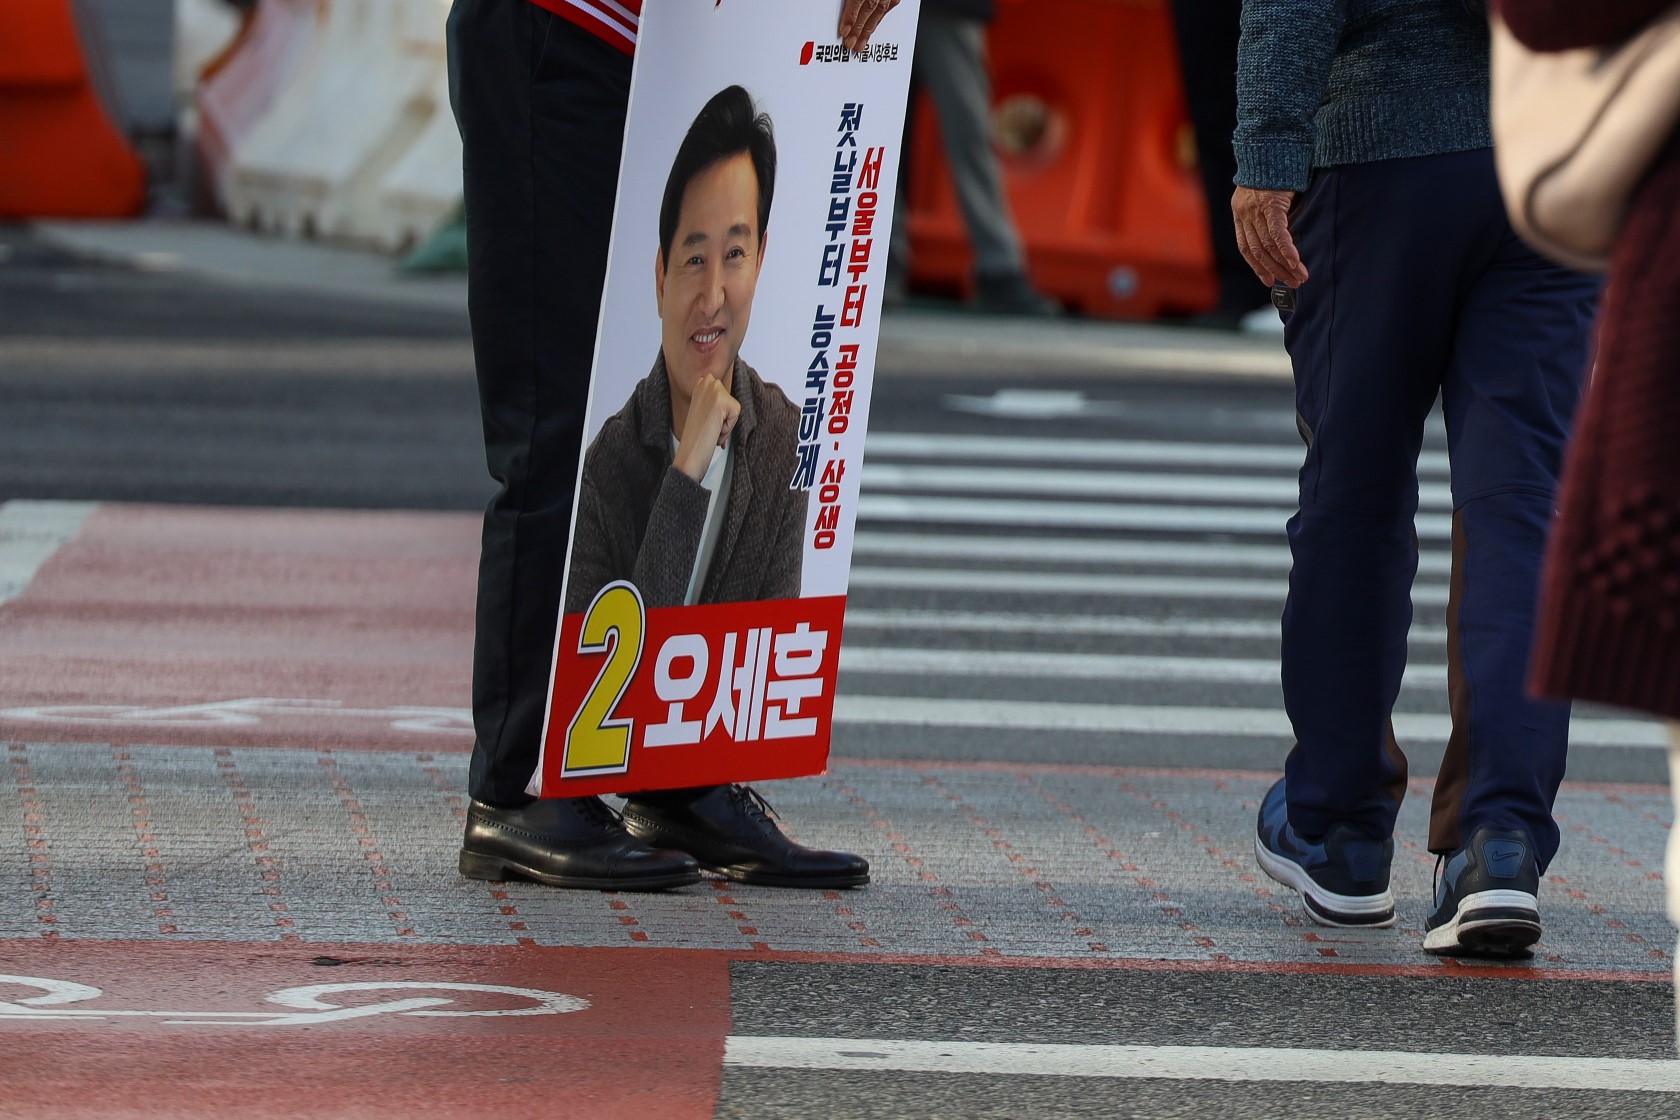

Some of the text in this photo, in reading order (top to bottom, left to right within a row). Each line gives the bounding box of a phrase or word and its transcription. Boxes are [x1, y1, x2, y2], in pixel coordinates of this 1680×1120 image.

[792, 102, 864, 489] 첫날부터 능숙하게
[839, 146, 885, 329] 서울부터
[560, 579, 829, 778] 2 오세훈
